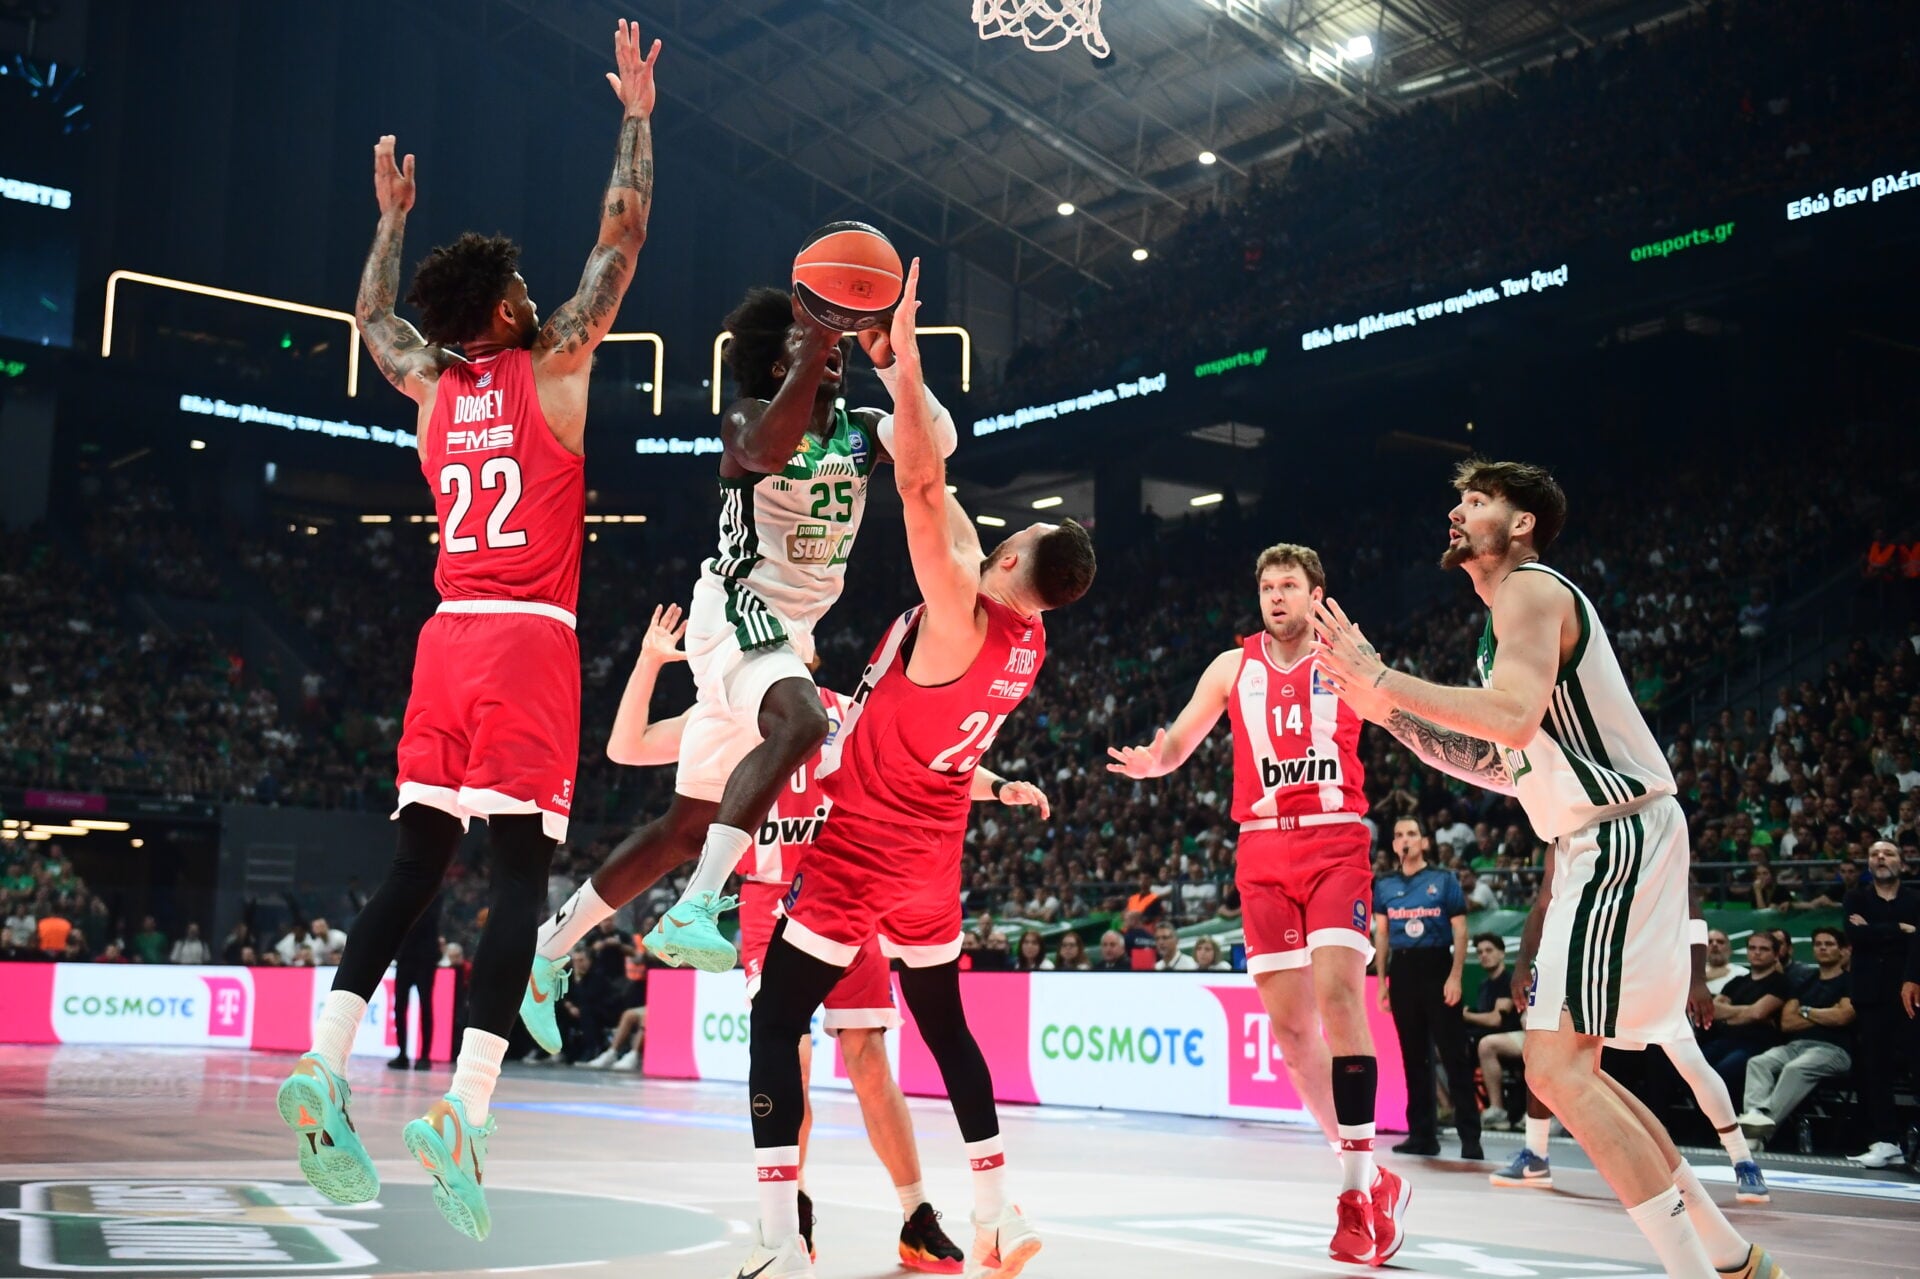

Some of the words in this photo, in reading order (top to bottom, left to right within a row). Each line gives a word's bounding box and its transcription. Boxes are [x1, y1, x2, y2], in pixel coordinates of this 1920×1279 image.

[1787, 193, 1830, 221] Εδώ
[1833, 187, 1868, 208] δεν
[1871, 170, 1920, 202] βλέπ
[1631, 222, 1735, 262] onsports.gr
[1500, 278, 1529, 297] Τον
[1195, 348, 1268, 378] onsports.gr
[446, 424, 514, 454] FMS
[440, 456, 528, 553] 22
[810, 481, 853, 522] 25
[1004, 647, 1037, 675] PETERS
[987, 680, 1028, 699] FMS
[1272, 704, 1303, 736] 14
[1261, 748, 1337, 788] bwin
[758, 807, 826, 845] bwi
[63, 995, 195, 1018] COSMOTE
[1041, 1024, 1204, 1067] COSMOTE
[758, 1168, 784, 1179] SA
[970, 1158, 994, 1169] SA
